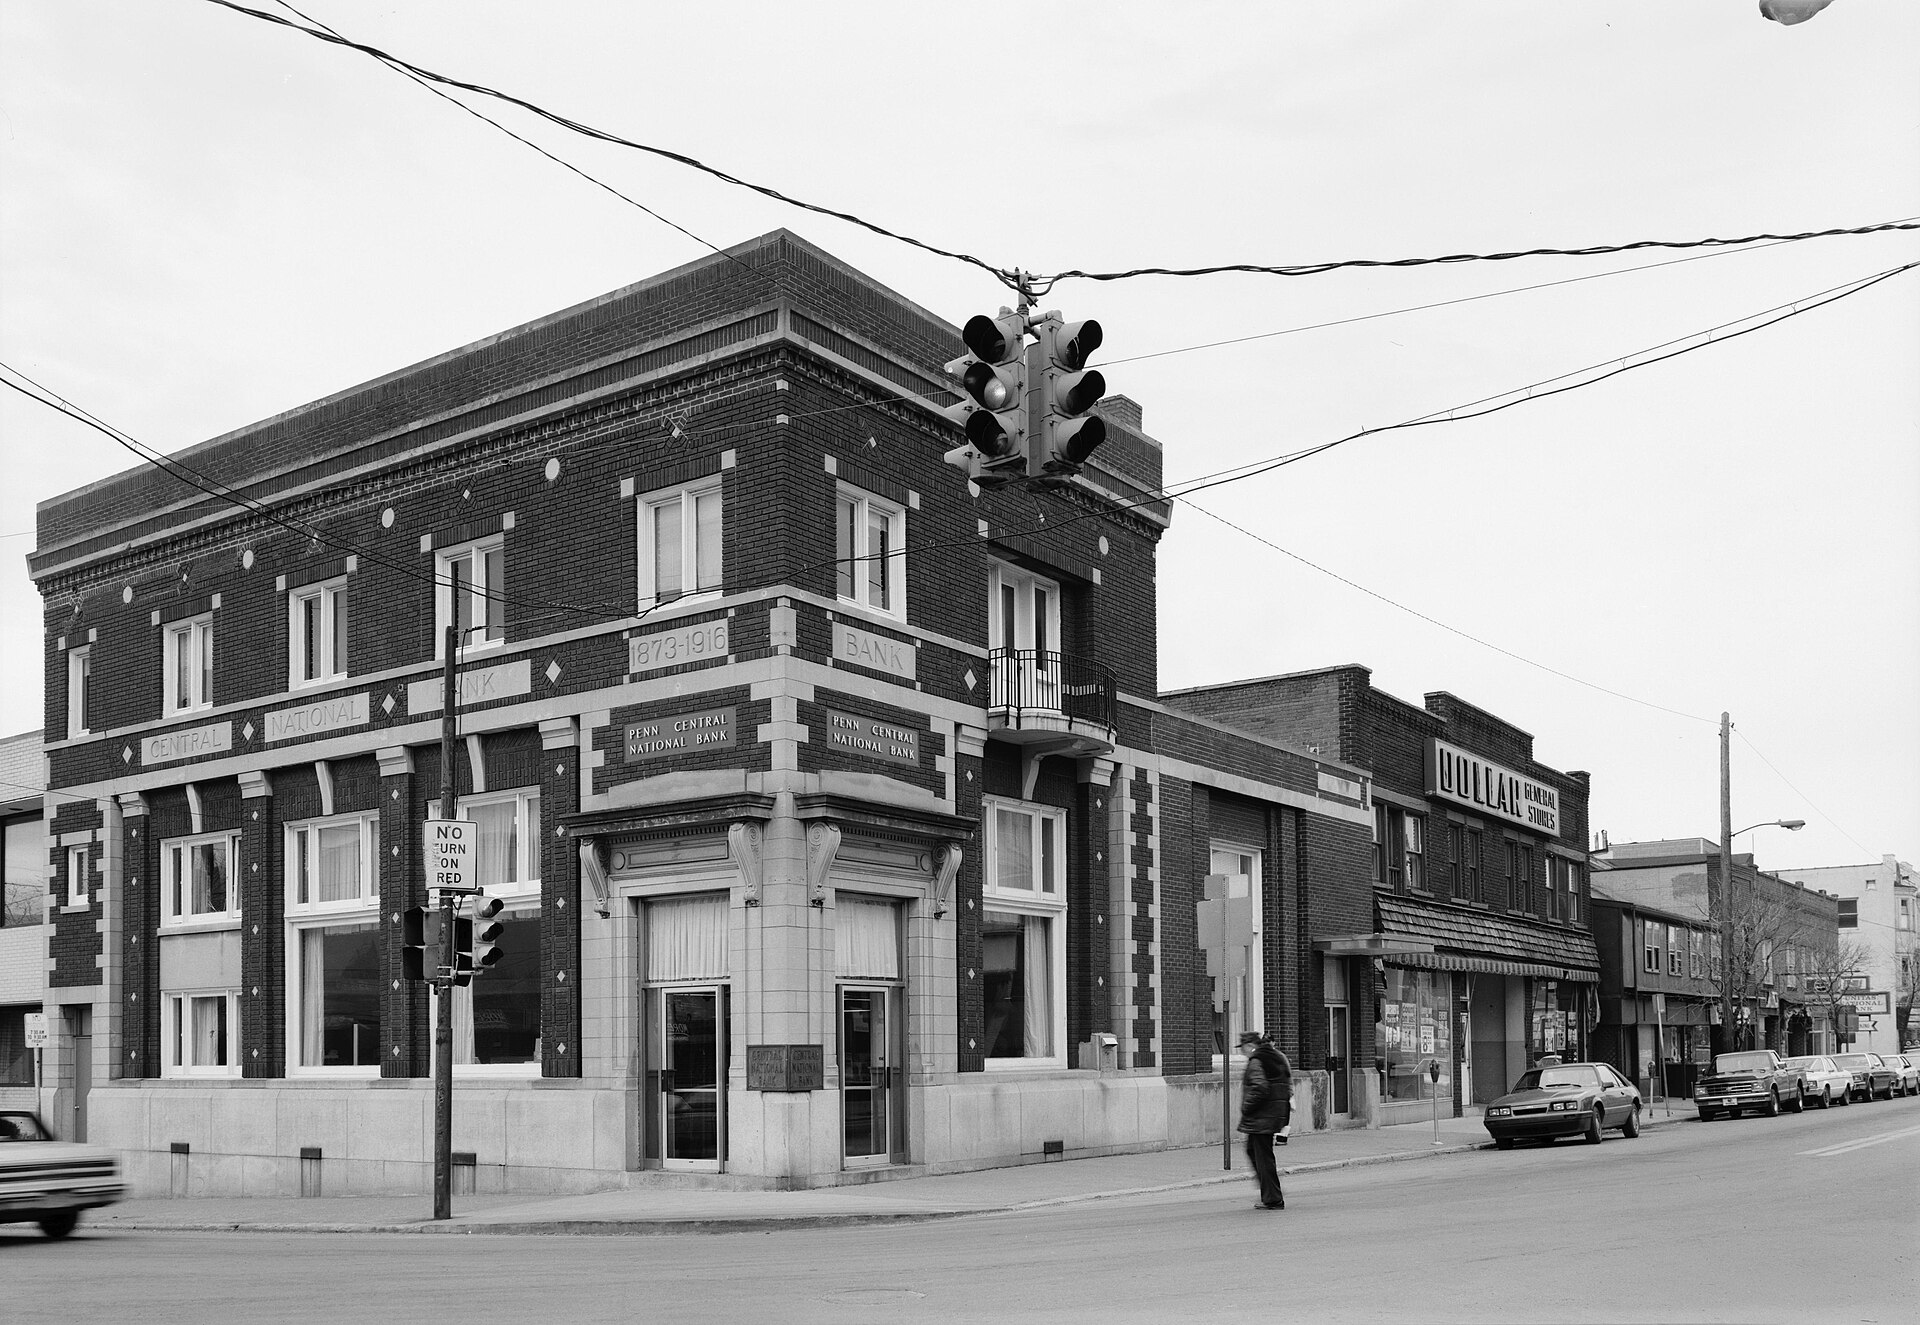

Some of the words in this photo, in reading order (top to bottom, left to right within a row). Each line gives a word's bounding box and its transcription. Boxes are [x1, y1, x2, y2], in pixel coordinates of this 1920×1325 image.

[631, 626, 726, 667] 1873-1916
[846, 632, 904, 671] BANK
[440, 673, 496, 703] ANK
[271, 700, 362, 736] NATIONAL
[629, 725, 660, 740] PENN
[674, 714, 729, 733] CENTRAL
[832, 715, 860, 731] PENN
[871, 725, 915, 744] CENTRAL
[150, 729, 222, 759] CENTRAL
[629, 737, 688, 755] NATIONAL
[696, 730, 728, 745] BANK
[832, 732, 884, 753] NATIONAL
[889, 745, 915, 759] BANK
[1524, 781, 1557, 811] GENERAL
[1528, 804, 1556, 831] STORES
[437, 826, 463, 840] NO
[440, 857, 459, 869] ON
[436, 872, 462, 884] RED
